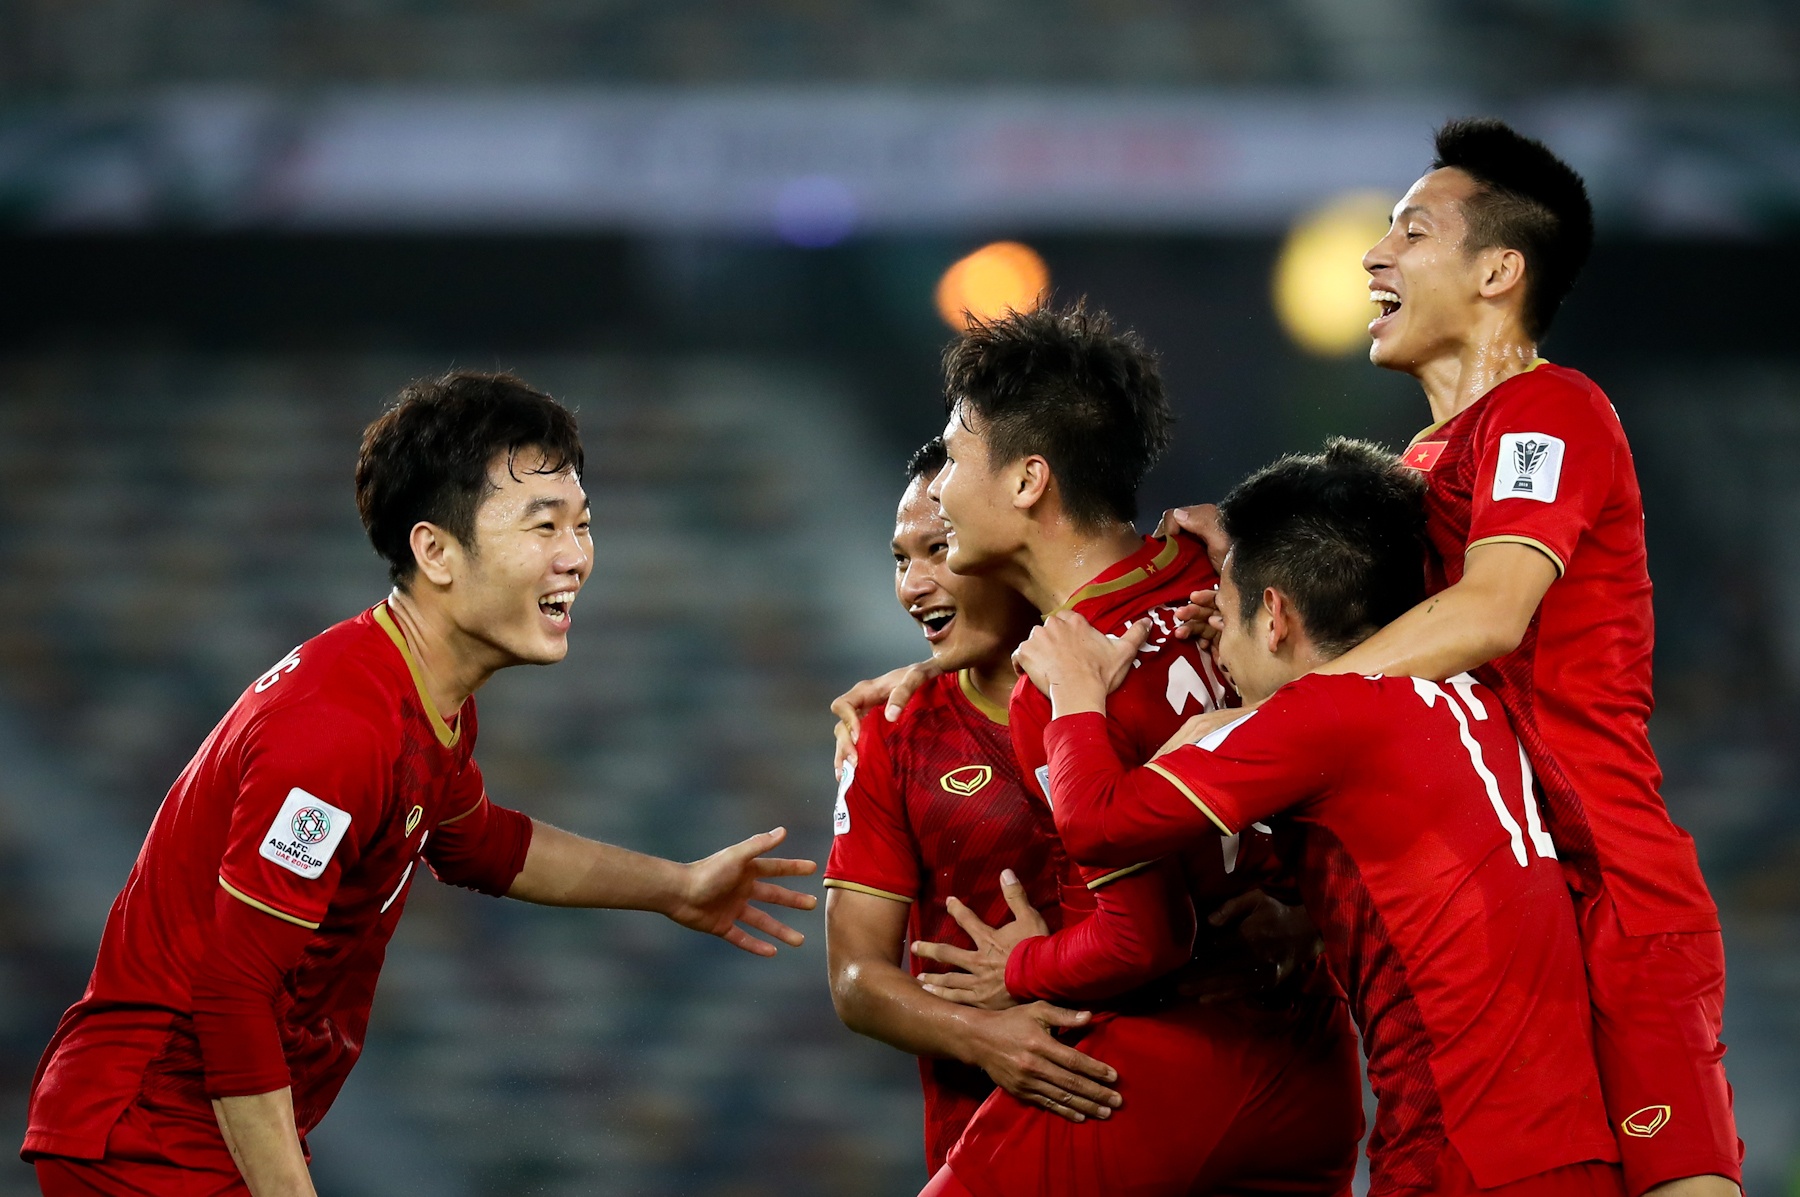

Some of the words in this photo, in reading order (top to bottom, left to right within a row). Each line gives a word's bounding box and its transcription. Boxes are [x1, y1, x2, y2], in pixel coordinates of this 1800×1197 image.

[269, 838, 301, 859] ASIAN
[301, 854, 323, 868] CUP
[290, 841, 308, 853] AFC
[275, 850, 291, 861] UAE
